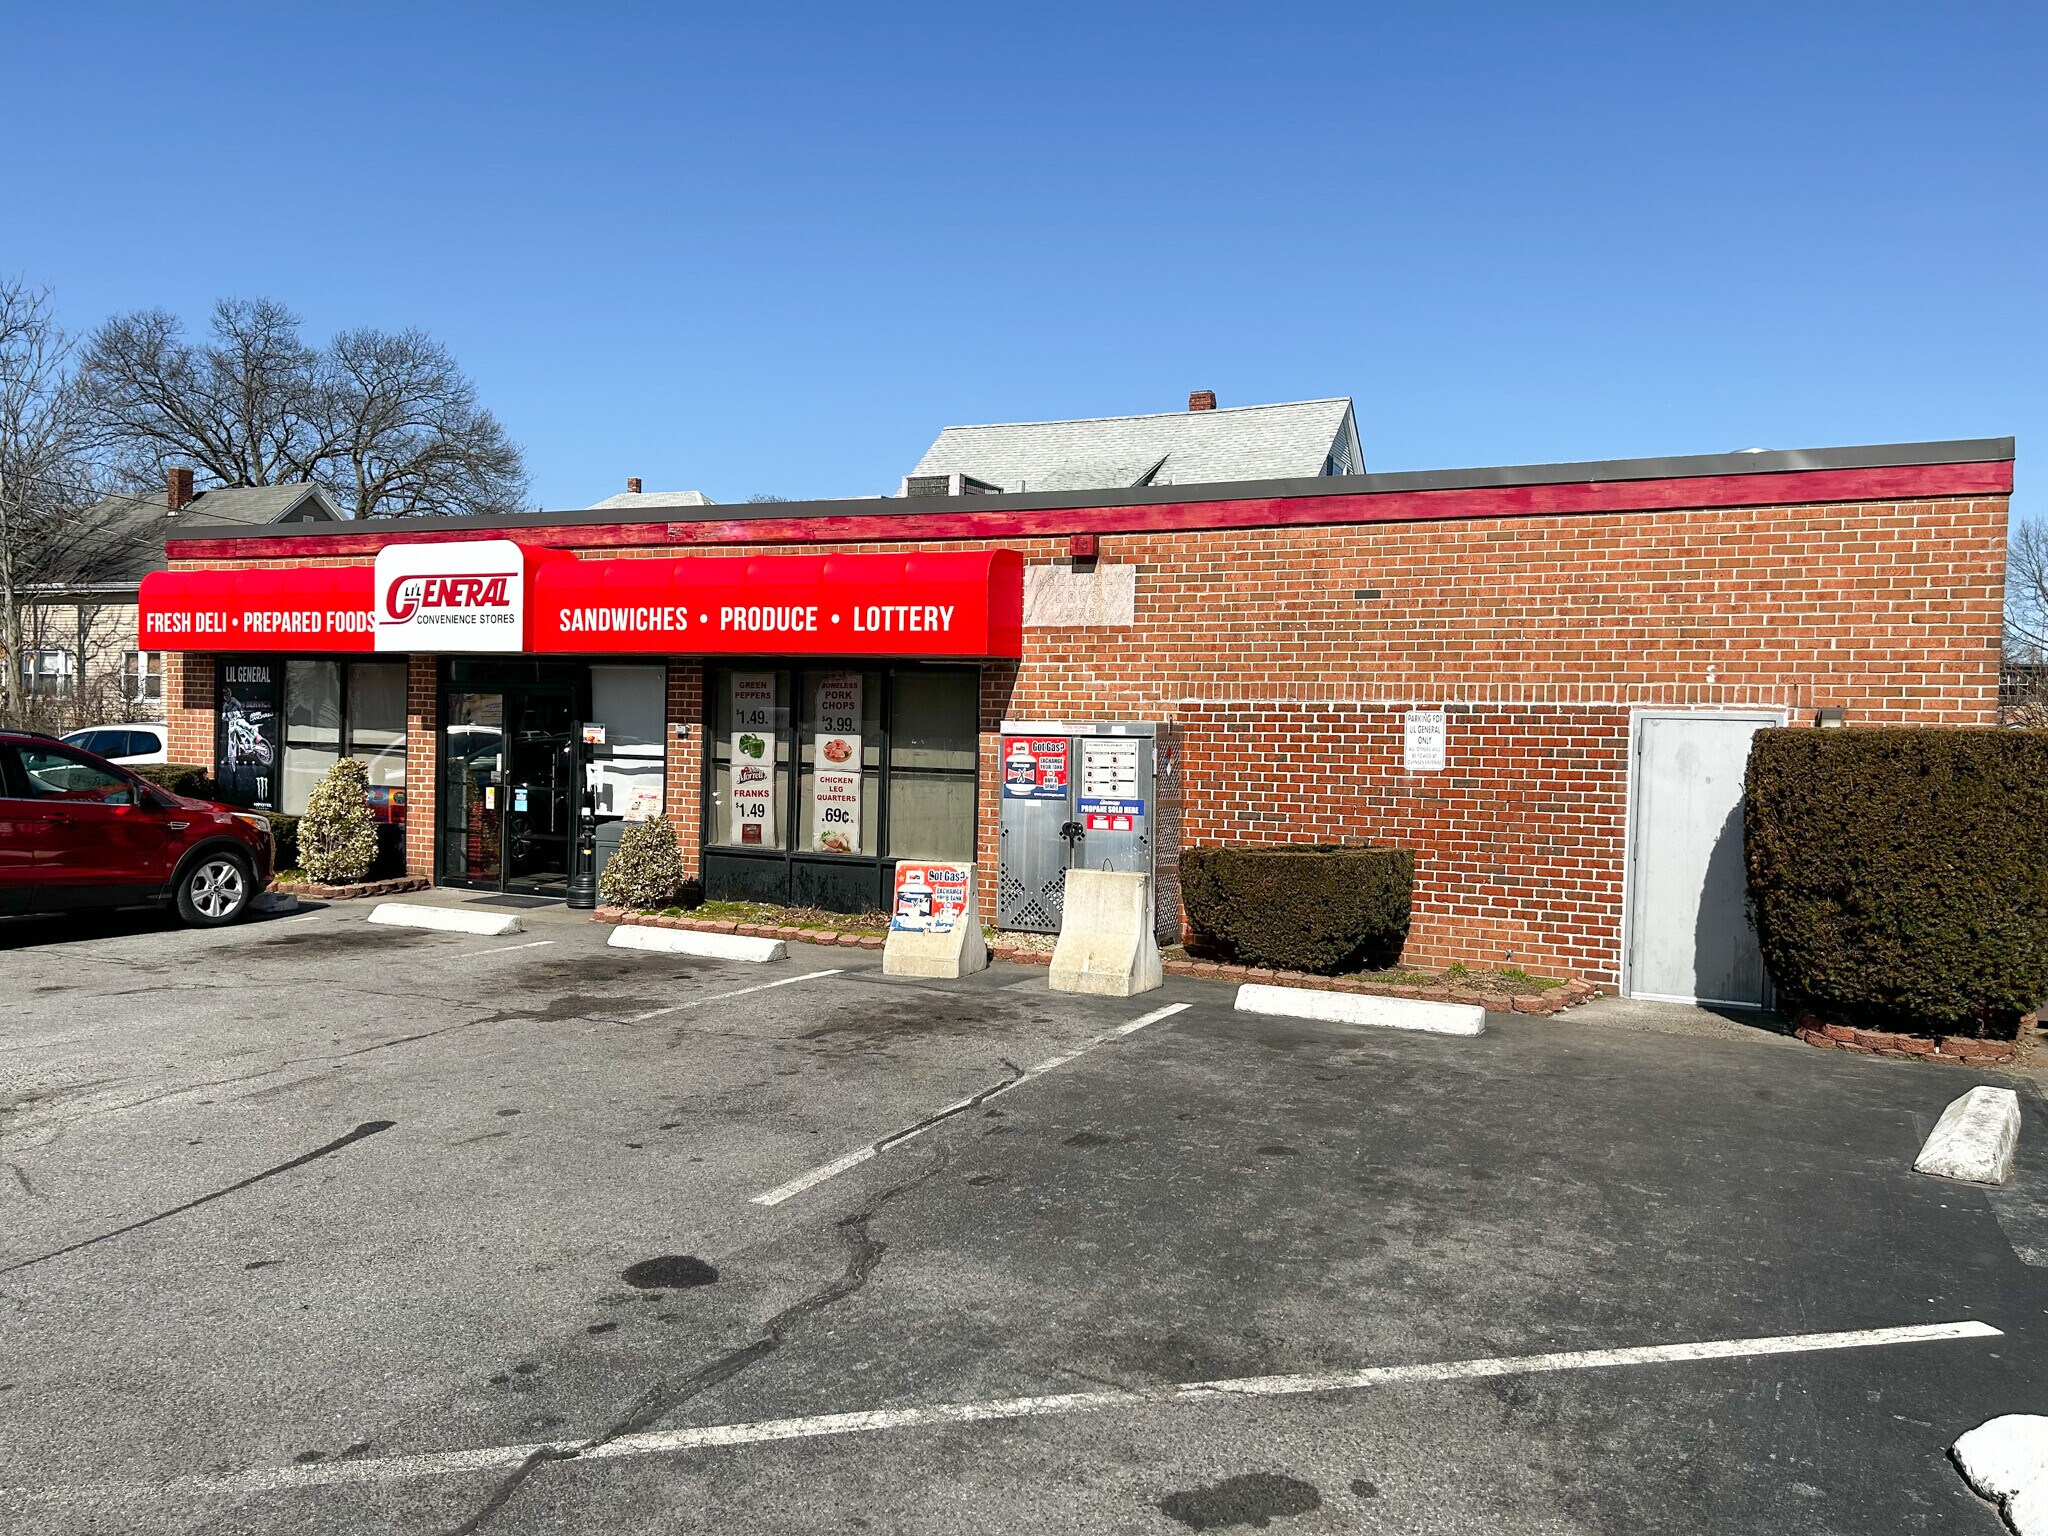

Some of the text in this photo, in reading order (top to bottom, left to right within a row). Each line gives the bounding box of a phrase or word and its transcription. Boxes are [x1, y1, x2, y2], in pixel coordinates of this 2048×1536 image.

[147, 610, 376, 633] FRESH DELI PREPARED FOODS
[416, 613, 515, 625] CONVENIENCE STORES
[559, 605, 955, 632] SANDWICHES PRODUCE LOTTERY
[225, 666, 271, 683] LIL GENERAL
[739, 681, 767, 689] GREEN
[735, 691, 771, 699] PEPPERS
[825, 691, 852, 699] PORK
[821, 701, 855, 710] CHOPS
[1408, 714, 1443, 723] PARKING FOR
[1417, 725, 1441, 734] GENERAL
[1417, 736, 1432, 745] ONLY
[1032, 741, 1045, 752] Got
[1046, 741, 1065, 752] Gas?
[820, 776, 853, 784] CHICKEN
[734, 789, 770, 798] FRANKS
[829, 785, 843, 793] LEG
[816, 794, 856, 802] QUARTERS
[735, 802, 765, 818] $1.49
[1081, 804, 1108, 813] PROPANE
[1107, 805, 1123, 814] SOLD
[944, 870, 965, 882] Gas?
